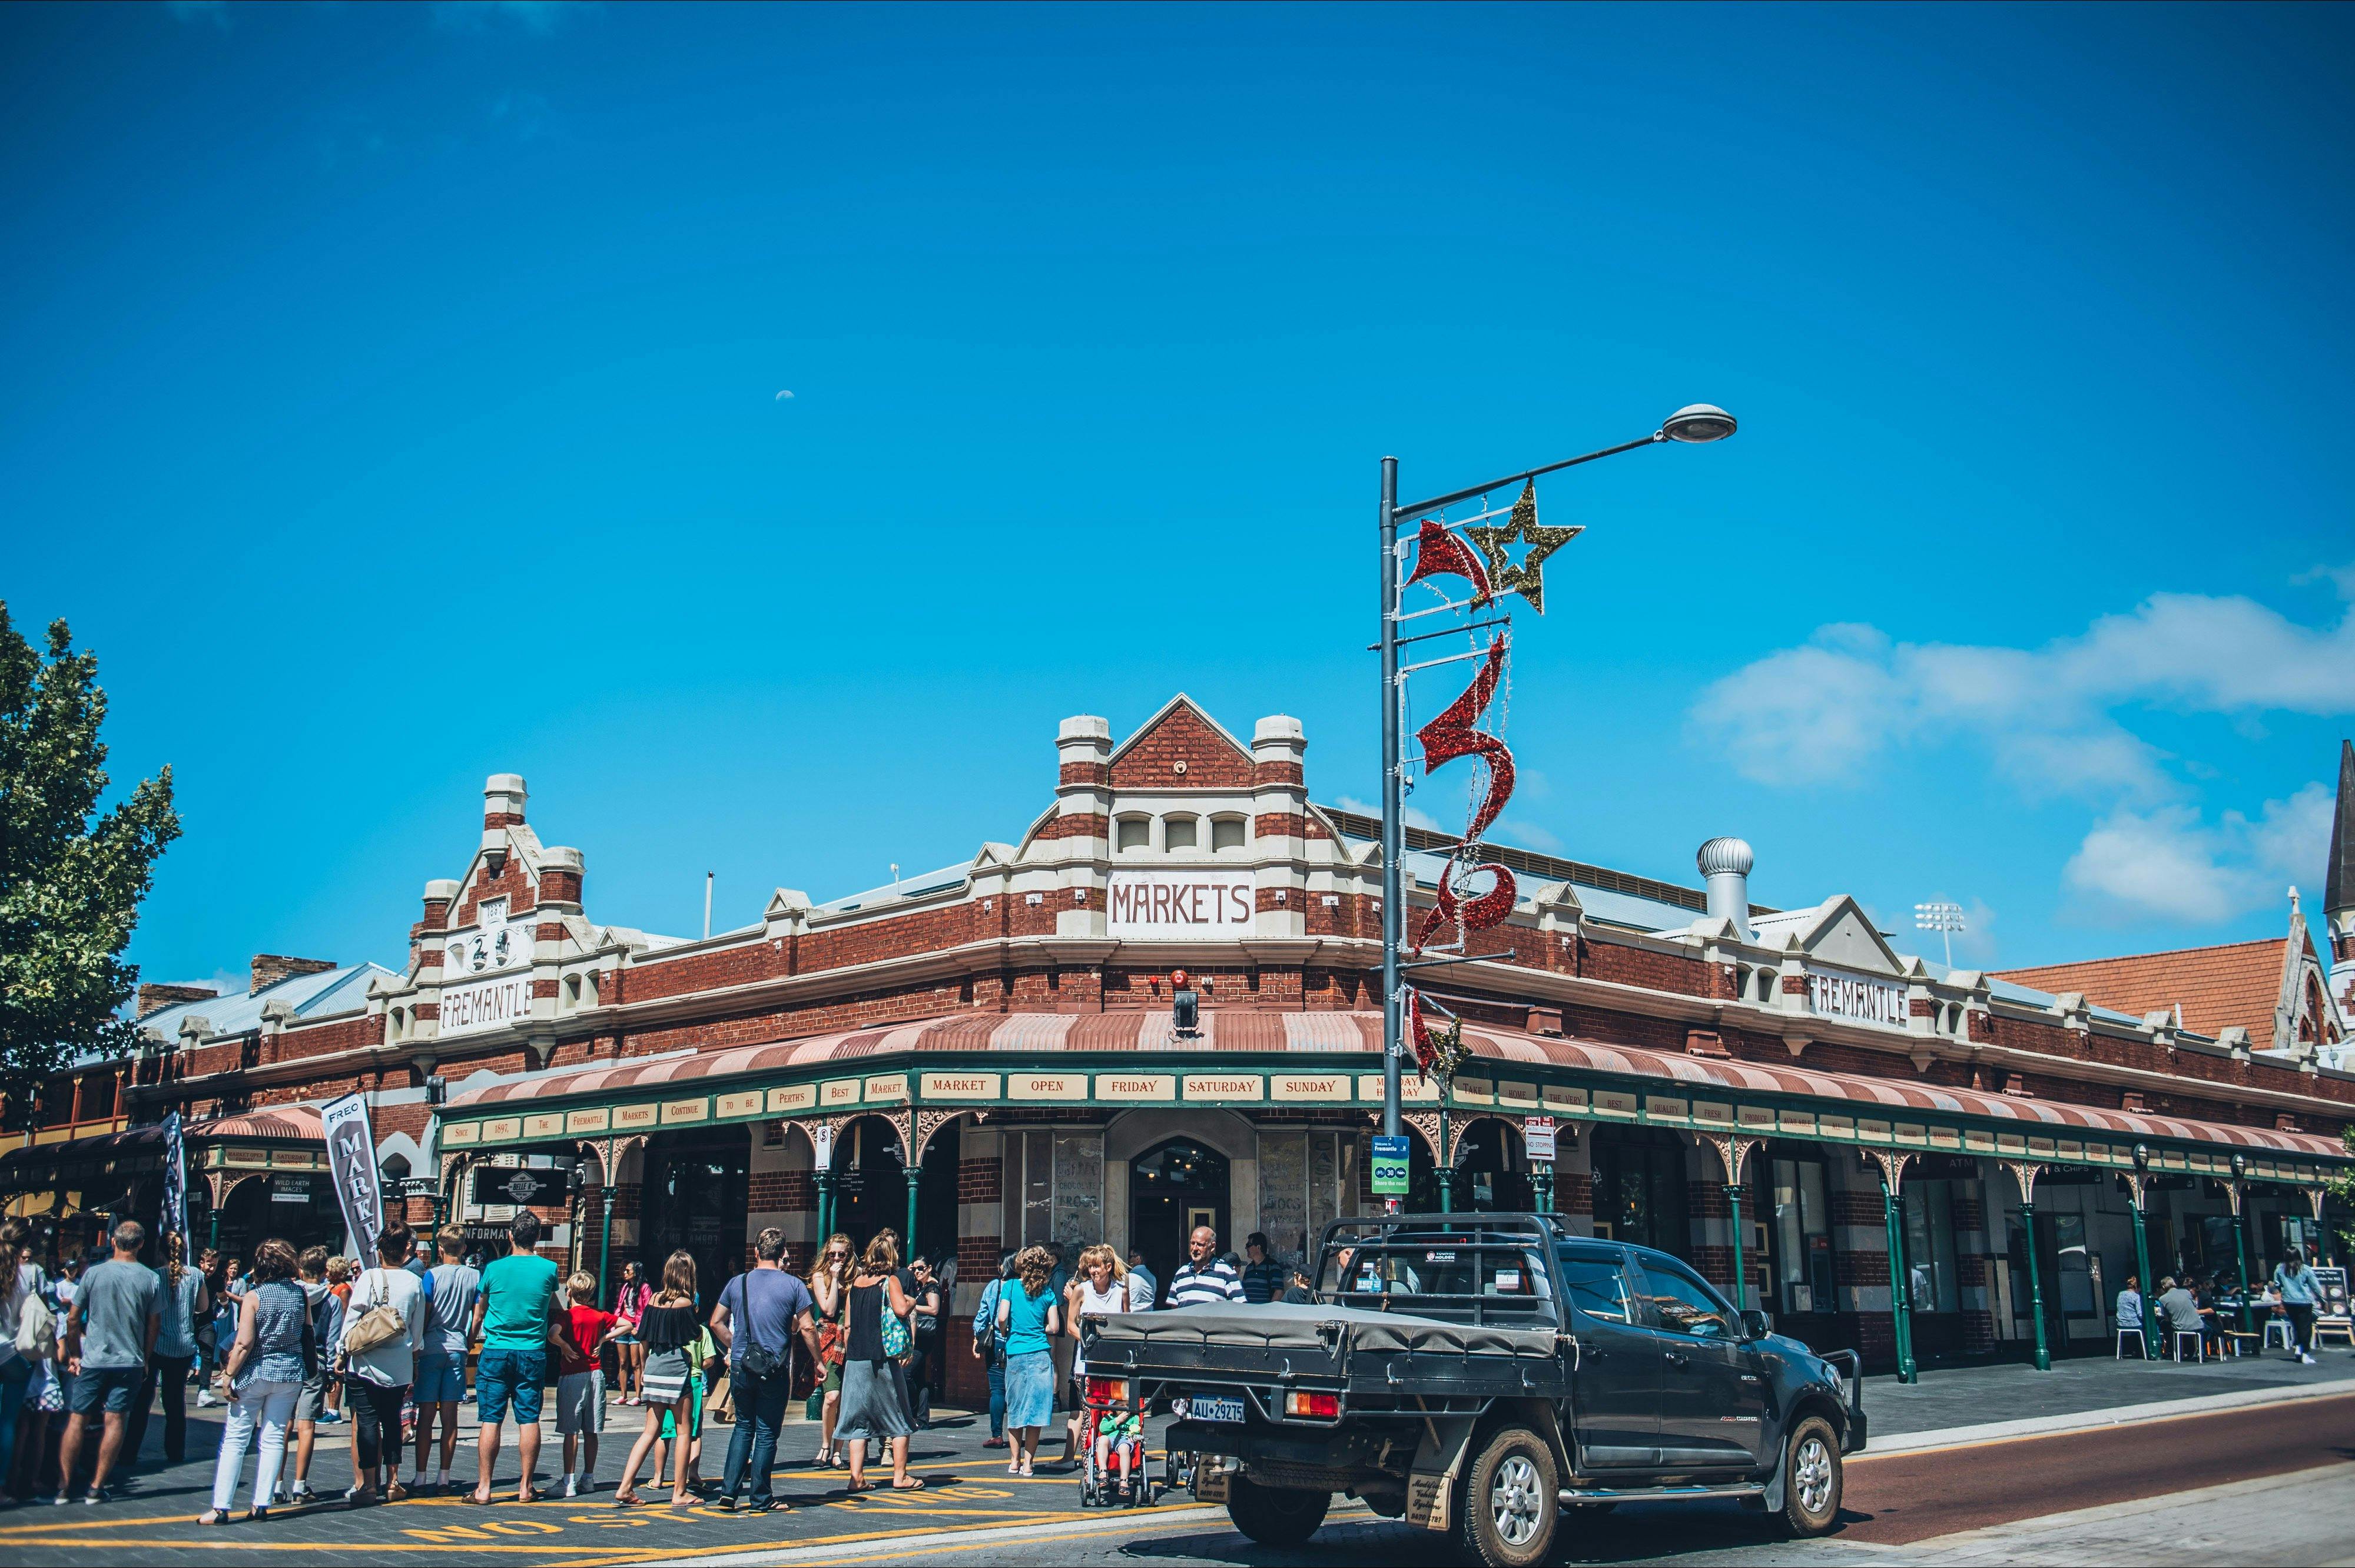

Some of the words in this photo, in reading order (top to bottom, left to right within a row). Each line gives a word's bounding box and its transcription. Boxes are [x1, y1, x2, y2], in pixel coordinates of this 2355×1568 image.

[487, 903, 502, 919] 1897
[1112, 884, 1250, 923] MARKETS
[442, 981, 532, 1029] FREMANTLE
[1808, 974, 1906, 1023] FREMANTLE
[933, 1080, 986, 1091] MARKET
[1031, 1081, 1063, 1091] OPEN
[1112, 1079, 1158, 1092] FRIDAY
[1189, 1080, 1256, 1092] SATURDAY
[1286, 1080, 1336, 1092] SUNDAY
[329, 1103, 359, 1122] FREO
[726, 1101, 734, 1109] TO
[745, 1099, 754, 1107] BE
[1508, 1089, 1527, 1099] HOME
[1549, 1094, 1561, 1104] THE
[1565, 1095, 1582, 1105] VERY
[1607, 1099, 1622, 1108] BEST
[1654, 1104, 1679, 1114] QUALITY
[1704, 1109, 1722, 1118] FRESH
[1744, 1114, 1767, 1123] PRODUCE
[1949, 1158, 1973, 1168] ATM
[400, 1520, 565, 1543] NO
